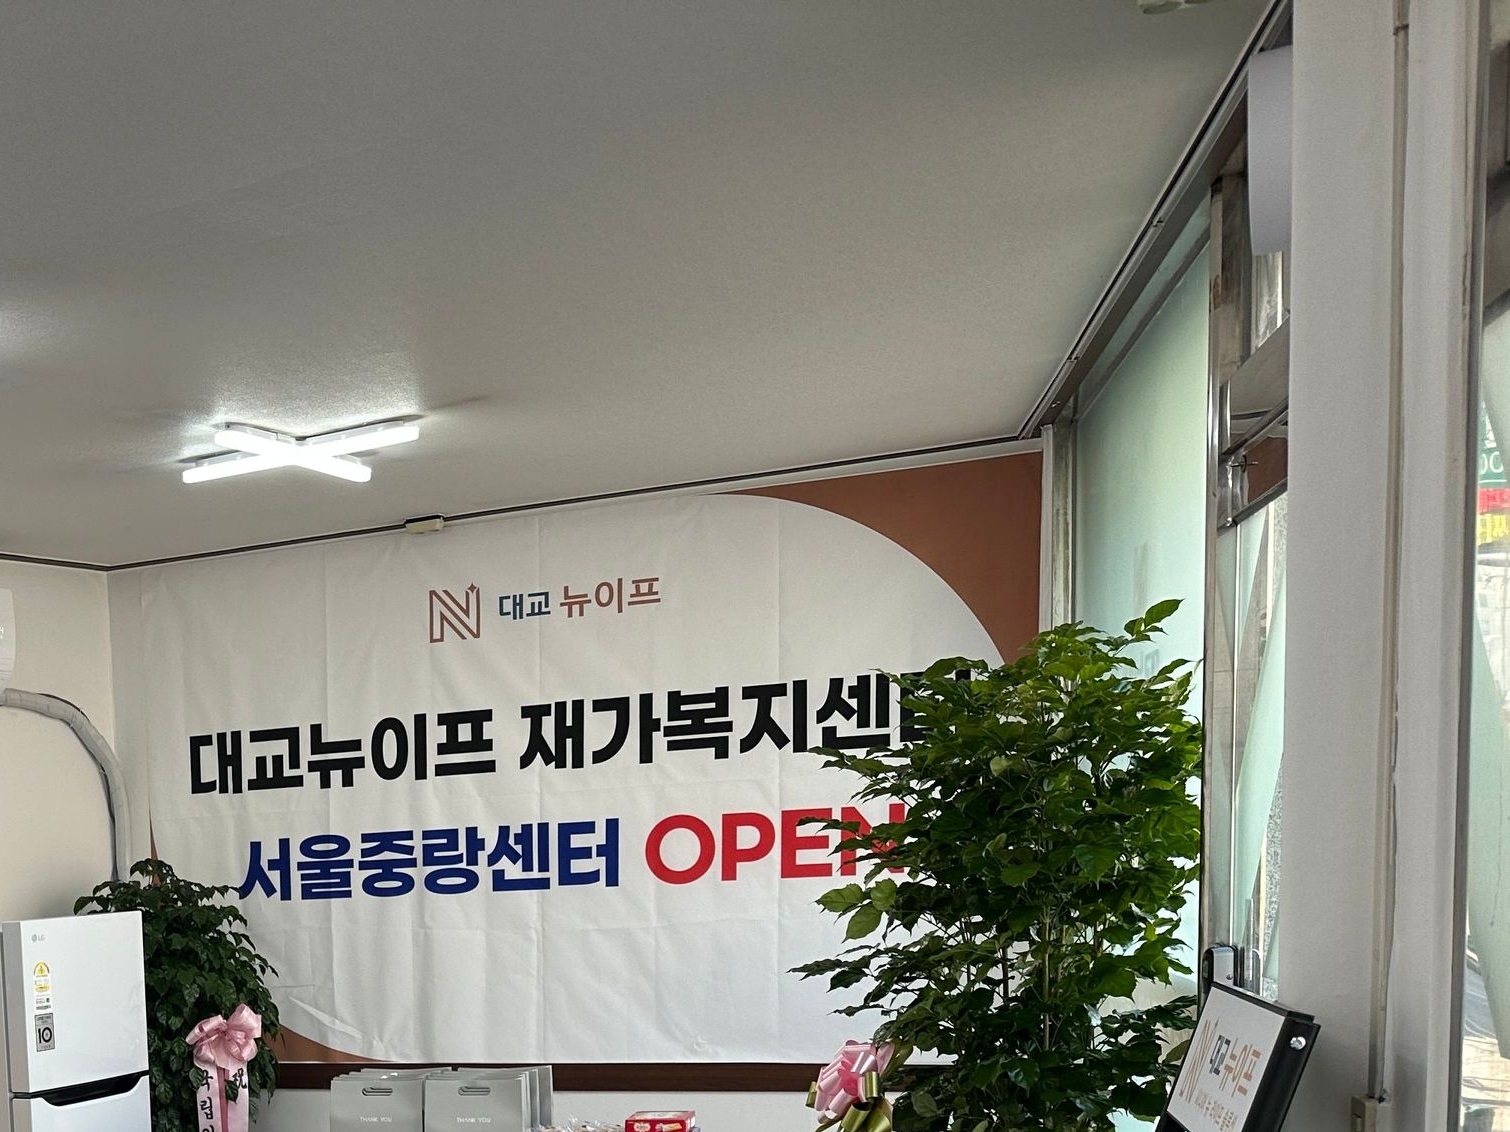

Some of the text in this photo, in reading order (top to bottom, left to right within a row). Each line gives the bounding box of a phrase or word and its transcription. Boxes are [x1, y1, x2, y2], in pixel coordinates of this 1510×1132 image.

[498, 591, 551, 620] 대교
[559, 577, 661, 618] 뉴이프
[190, 669, 972, 796] 대교뉴이프 재가복지센
[239, 803, 906, 901] 서울중랑센터 OPEN
[38, 1026, 53, 1043] 10
